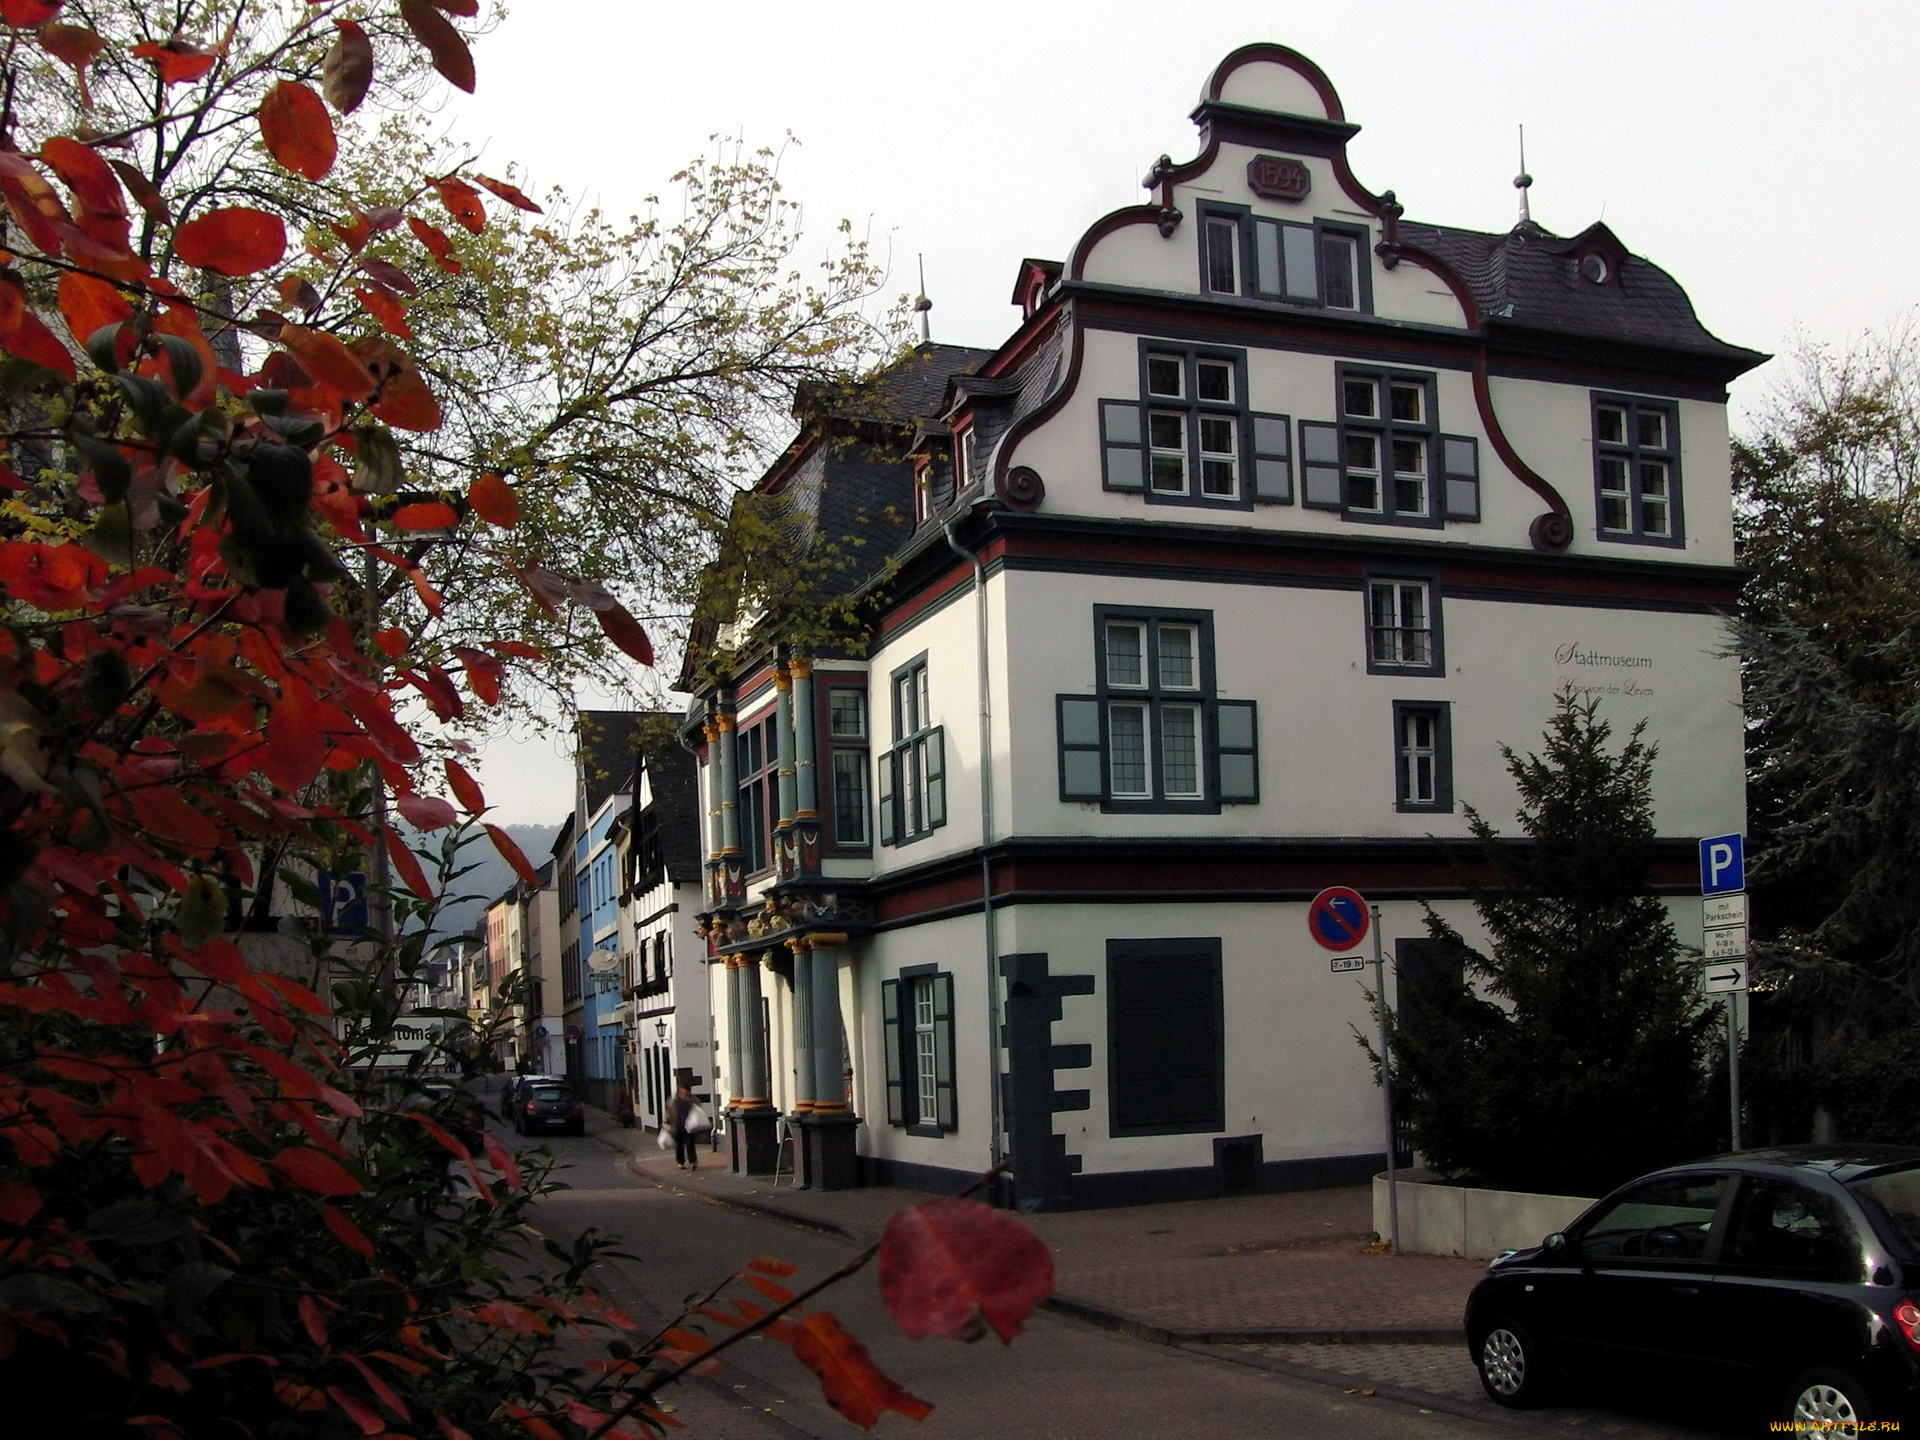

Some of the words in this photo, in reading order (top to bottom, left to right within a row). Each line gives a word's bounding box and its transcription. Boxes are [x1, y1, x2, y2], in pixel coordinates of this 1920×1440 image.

[1258, 163, 1304, 190] 1594
[1555, 641, 1653, 668] Stadtmuseum
[1587, 686, 1604, 694] von
[1607, 683, 1620, 695] der
[1623, 678, 1654, 698] Leyen
[1710, 843, 1733, 886] P
[330, 879, 356, 927] P
[1705, 911, 1743, 922] Parkschein
